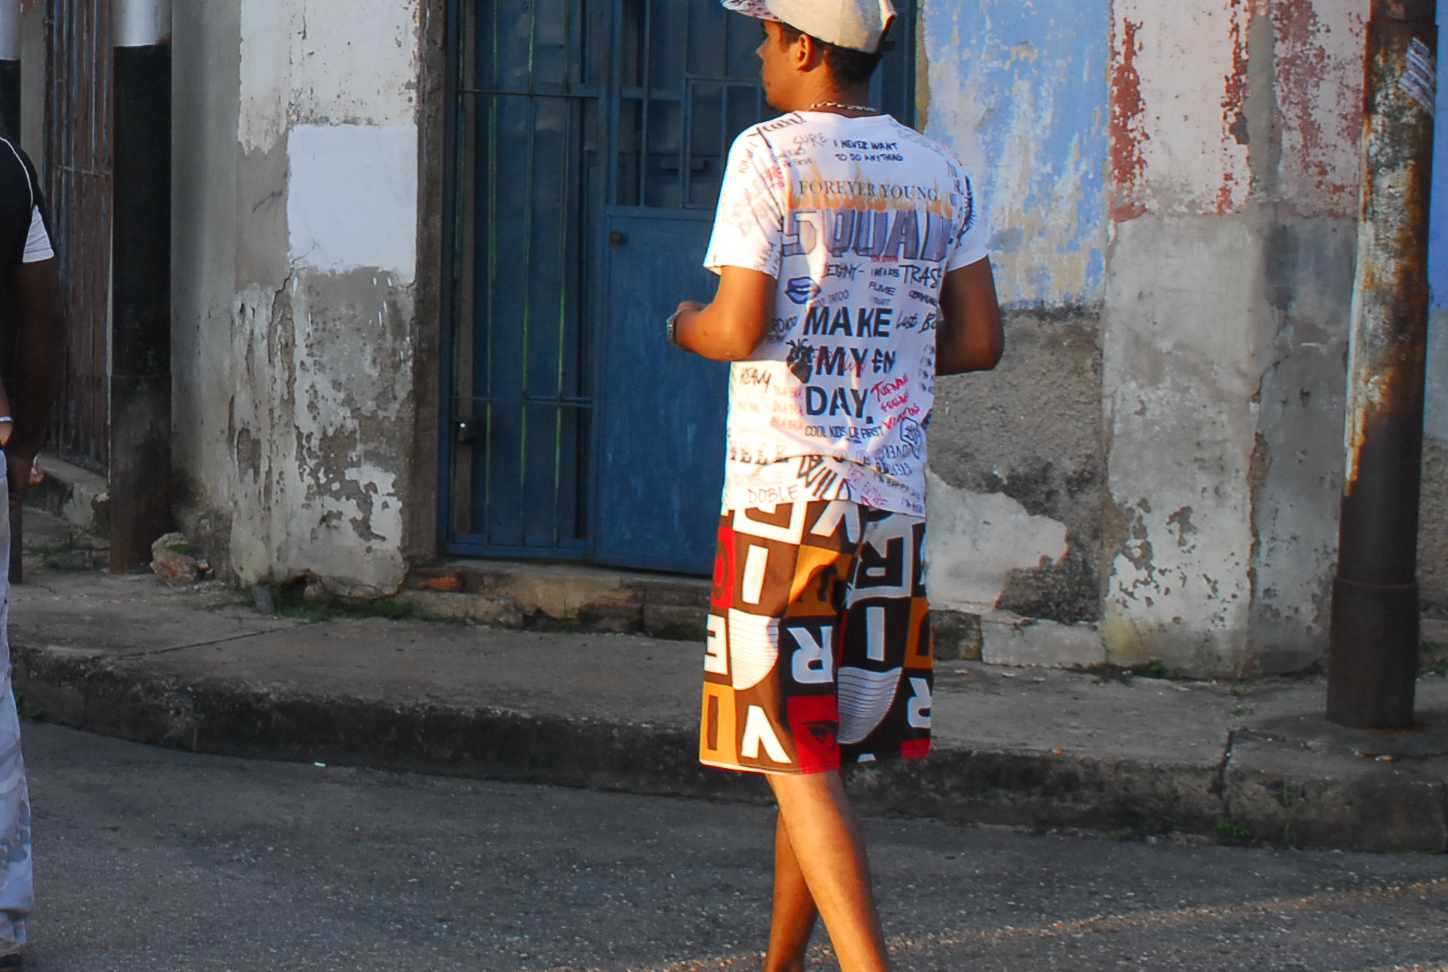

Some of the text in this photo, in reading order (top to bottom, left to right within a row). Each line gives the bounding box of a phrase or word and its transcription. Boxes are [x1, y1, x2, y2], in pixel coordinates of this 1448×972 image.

[840, 139, 868, 150] NEVER
[870, 140, 899, 151] WANT
[835, 153, 904, 162] TO DO ANYTHING
[798, 180, 939, 202] FOREVER YOUNG
[803, 306, 894, 338] MAKE
[815, 345, 870, 378] MY
[805, 386, 874, 425] DAY.
[805, 425, 827, 438] COOL
